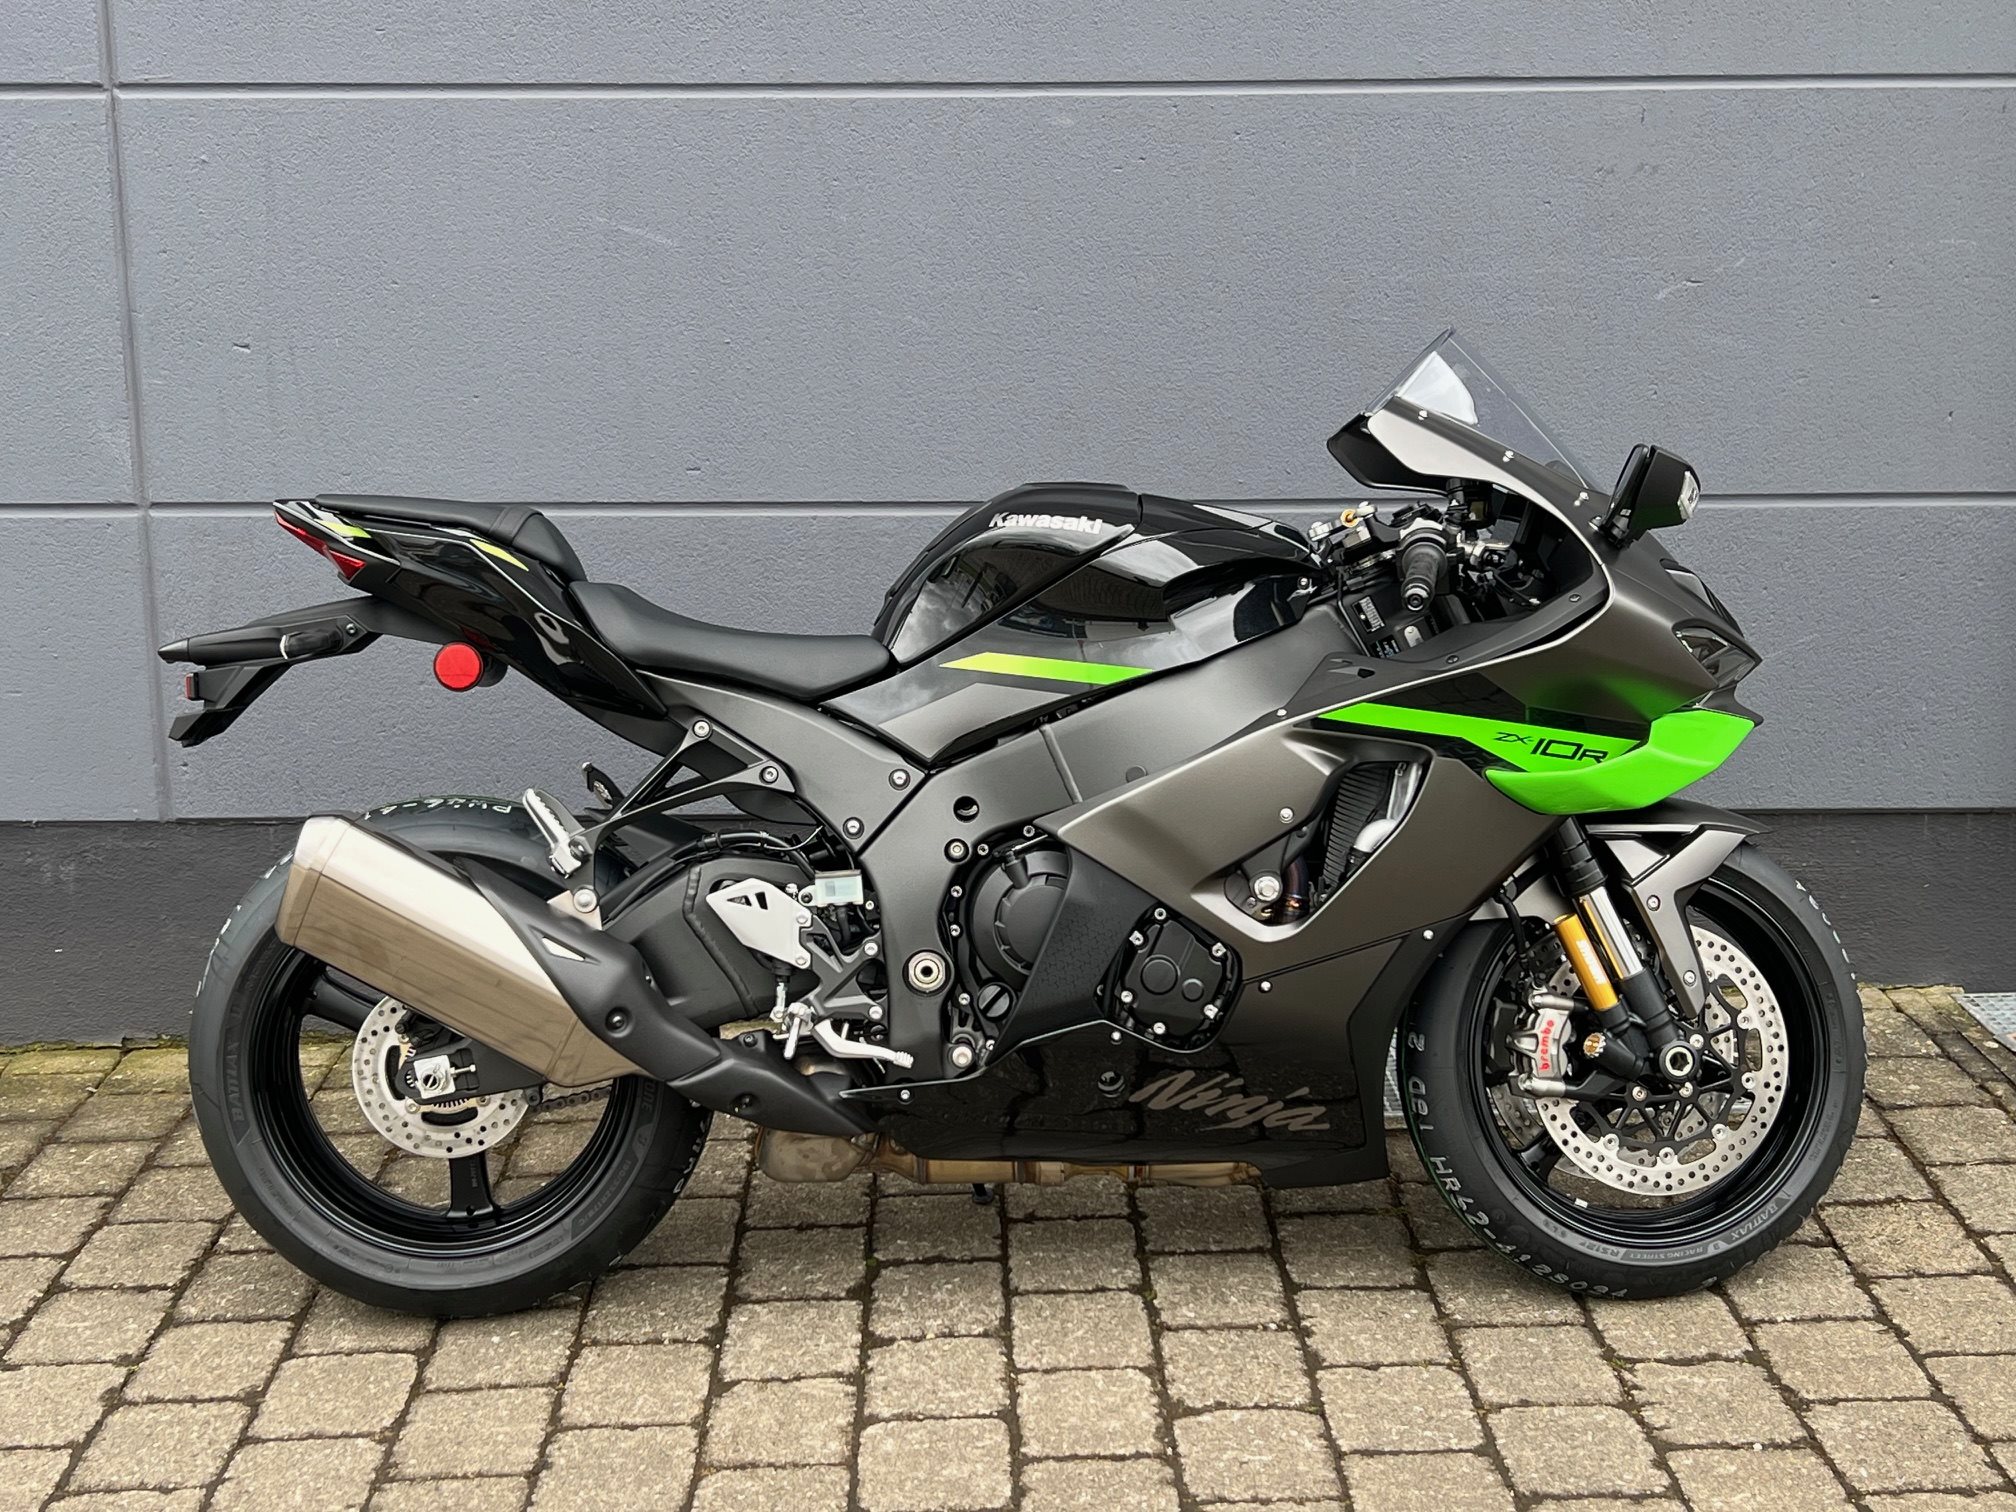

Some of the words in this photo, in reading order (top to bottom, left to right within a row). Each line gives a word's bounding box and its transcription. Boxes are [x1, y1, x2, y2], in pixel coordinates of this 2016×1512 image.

[989, 512, 1103, 535] Kawasaki
[1539, 1020, 1555, 1072] brembo
[1128, 1070, 1331, 1131] Ninja
[1730, 1203, 1779, 1241] BATTLAX
